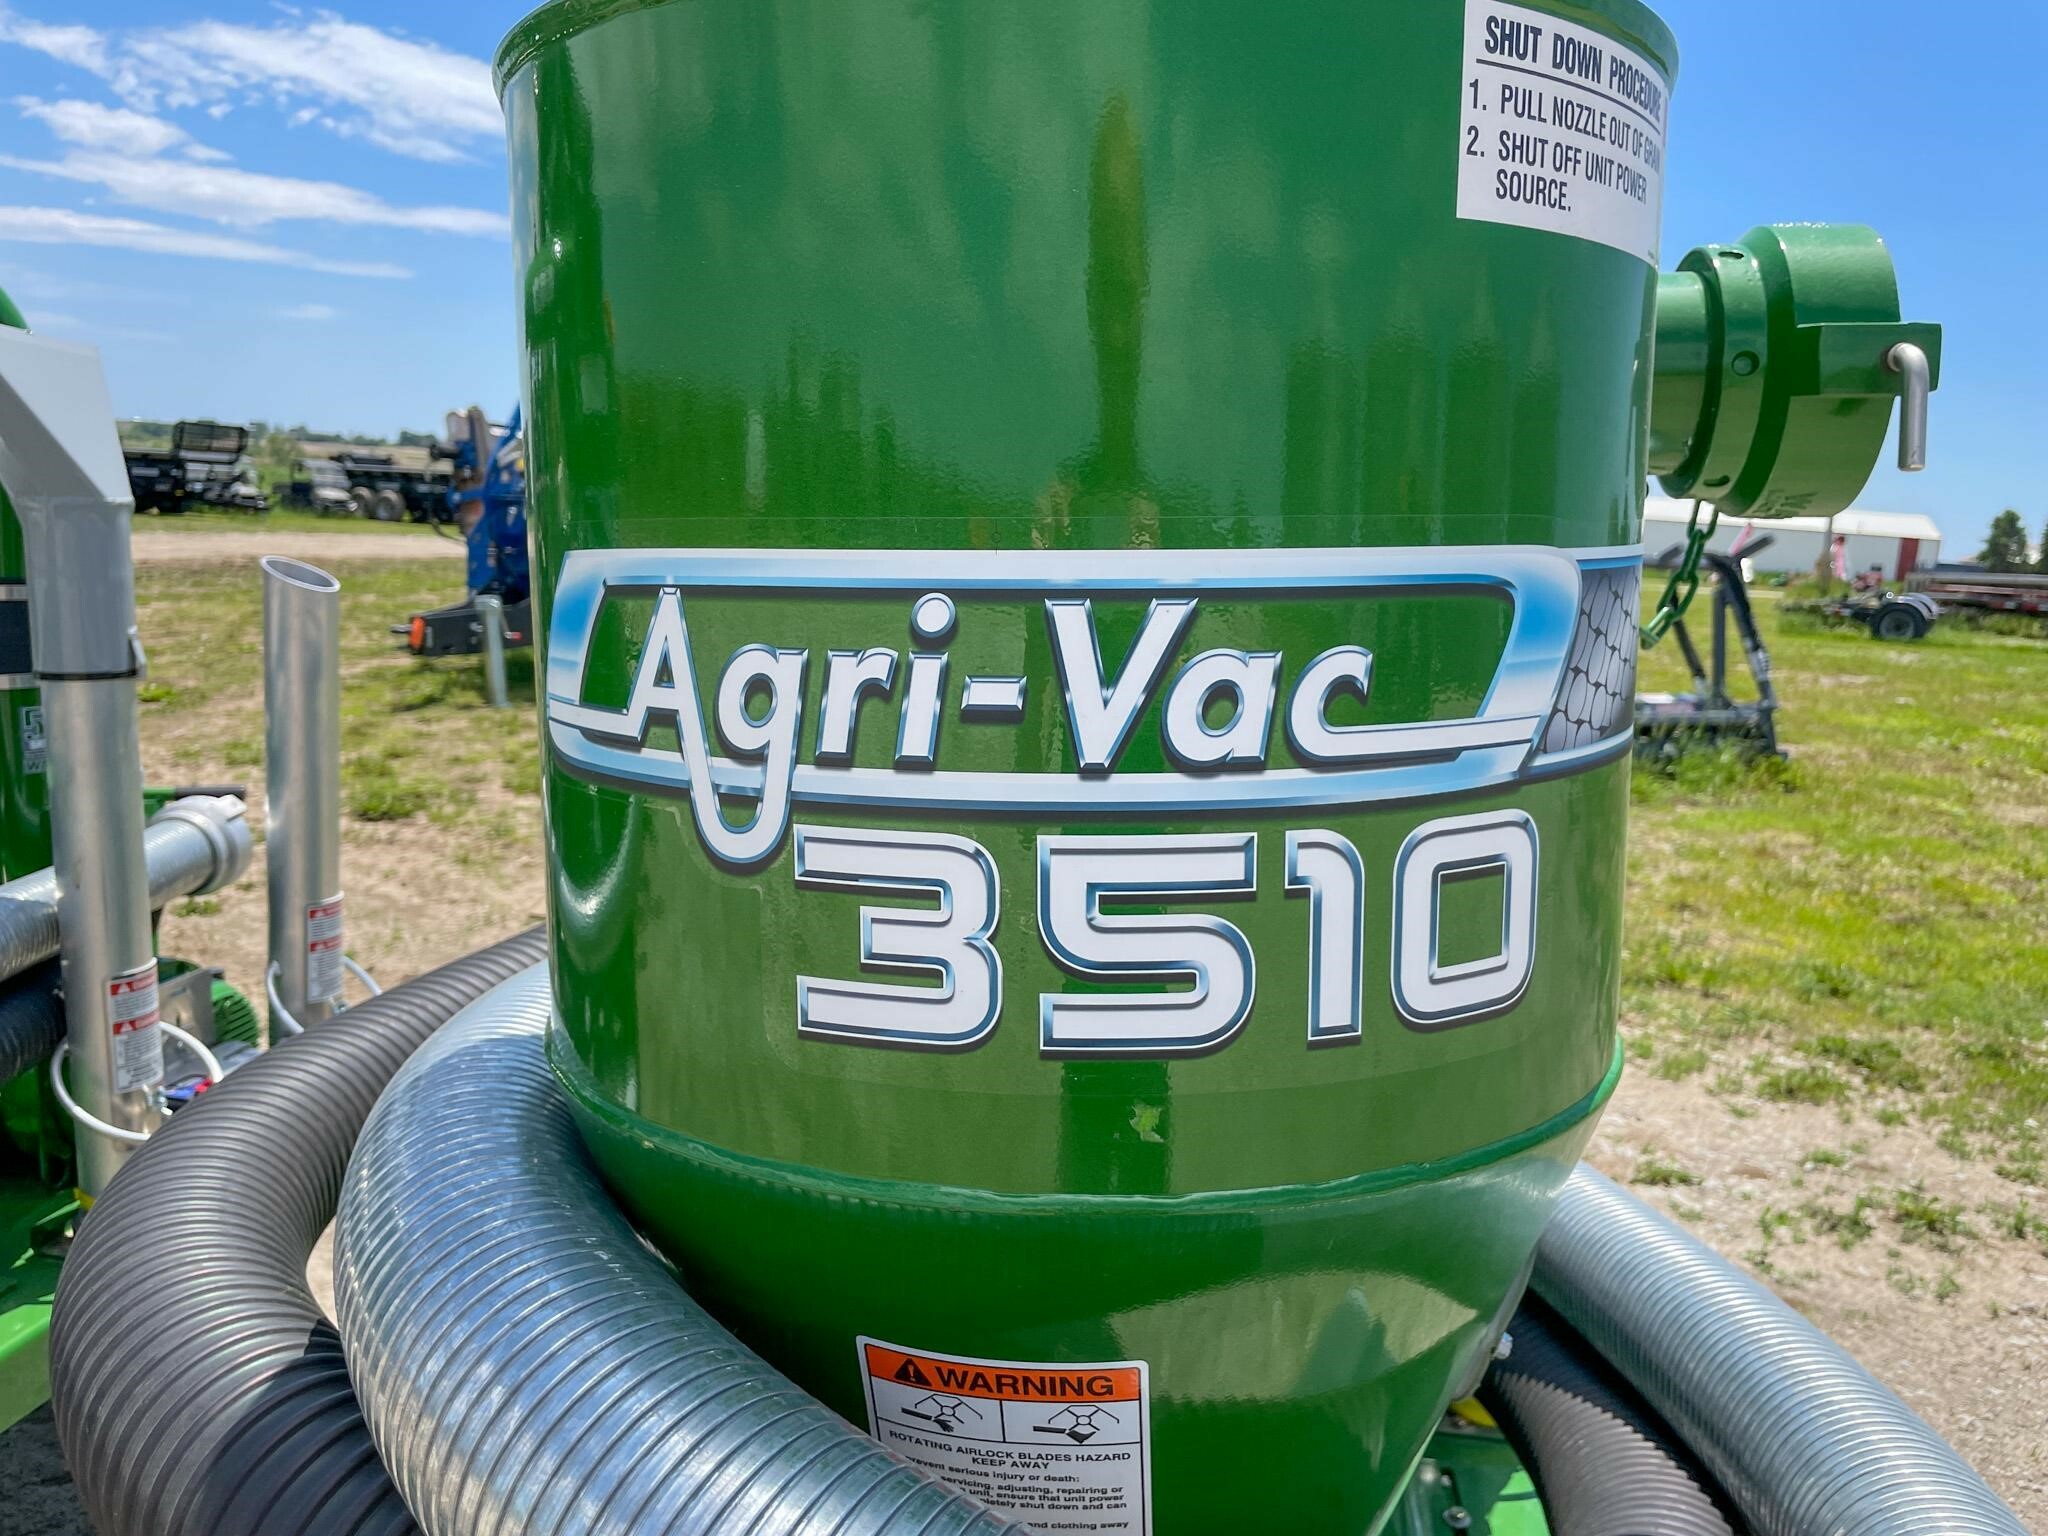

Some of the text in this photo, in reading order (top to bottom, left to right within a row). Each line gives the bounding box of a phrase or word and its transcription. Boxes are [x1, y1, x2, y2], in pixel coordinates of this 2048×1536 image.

[1485, 15, 1662, 123] SHUT DOWN PROCEDURE
[1469, 78, 1487, 111] 1.
[1500, 83, 1547, 124] PULL
[1552, 95, 1606, 142] NOZZLE
[1609, 116, 1631, 149] OUT
[1632, 127, 1644, 157] OF
[1466, 125, 1648, 205] 2. SHUT OFF UNIT POWER
[1496, 168, 1572, 212] SOURCE.
[616, 586, 1376, 863] Agri-Vac
[793, 808, 1540, 1054] 3510
[935, 1366, 1114, 1397] WARNING
[889, 1430, 1131, 1462] ROTATING AIRLOCK BLADES HAZARD
[948, 1465, 990, 1478] serious
[993, 1470, 1025, 1482] injury
[1044, 1474, 1080, 1483] death:
[972, 1457, 1050, 1470] KEEP AWAY
[996, 1492, 1036, 1501] ensure
[1038, 1494, 1061, 1502] that
[1063, 1494, 1086, 1503] unit
[1088, 1494, 1124, 1503] power
[1019, 1501, 1045, 1509] shut
[1047, 1502, 1079, 1511] down
[1081, 1502, 1104, 1510] and
[1106, 1502, 1128, 1510] can
[1056, 1486, 1108, 1495] repairing
[1050, 1521, 1098, 1531] clothing
[1100, 1521, 1130, 1529] away
